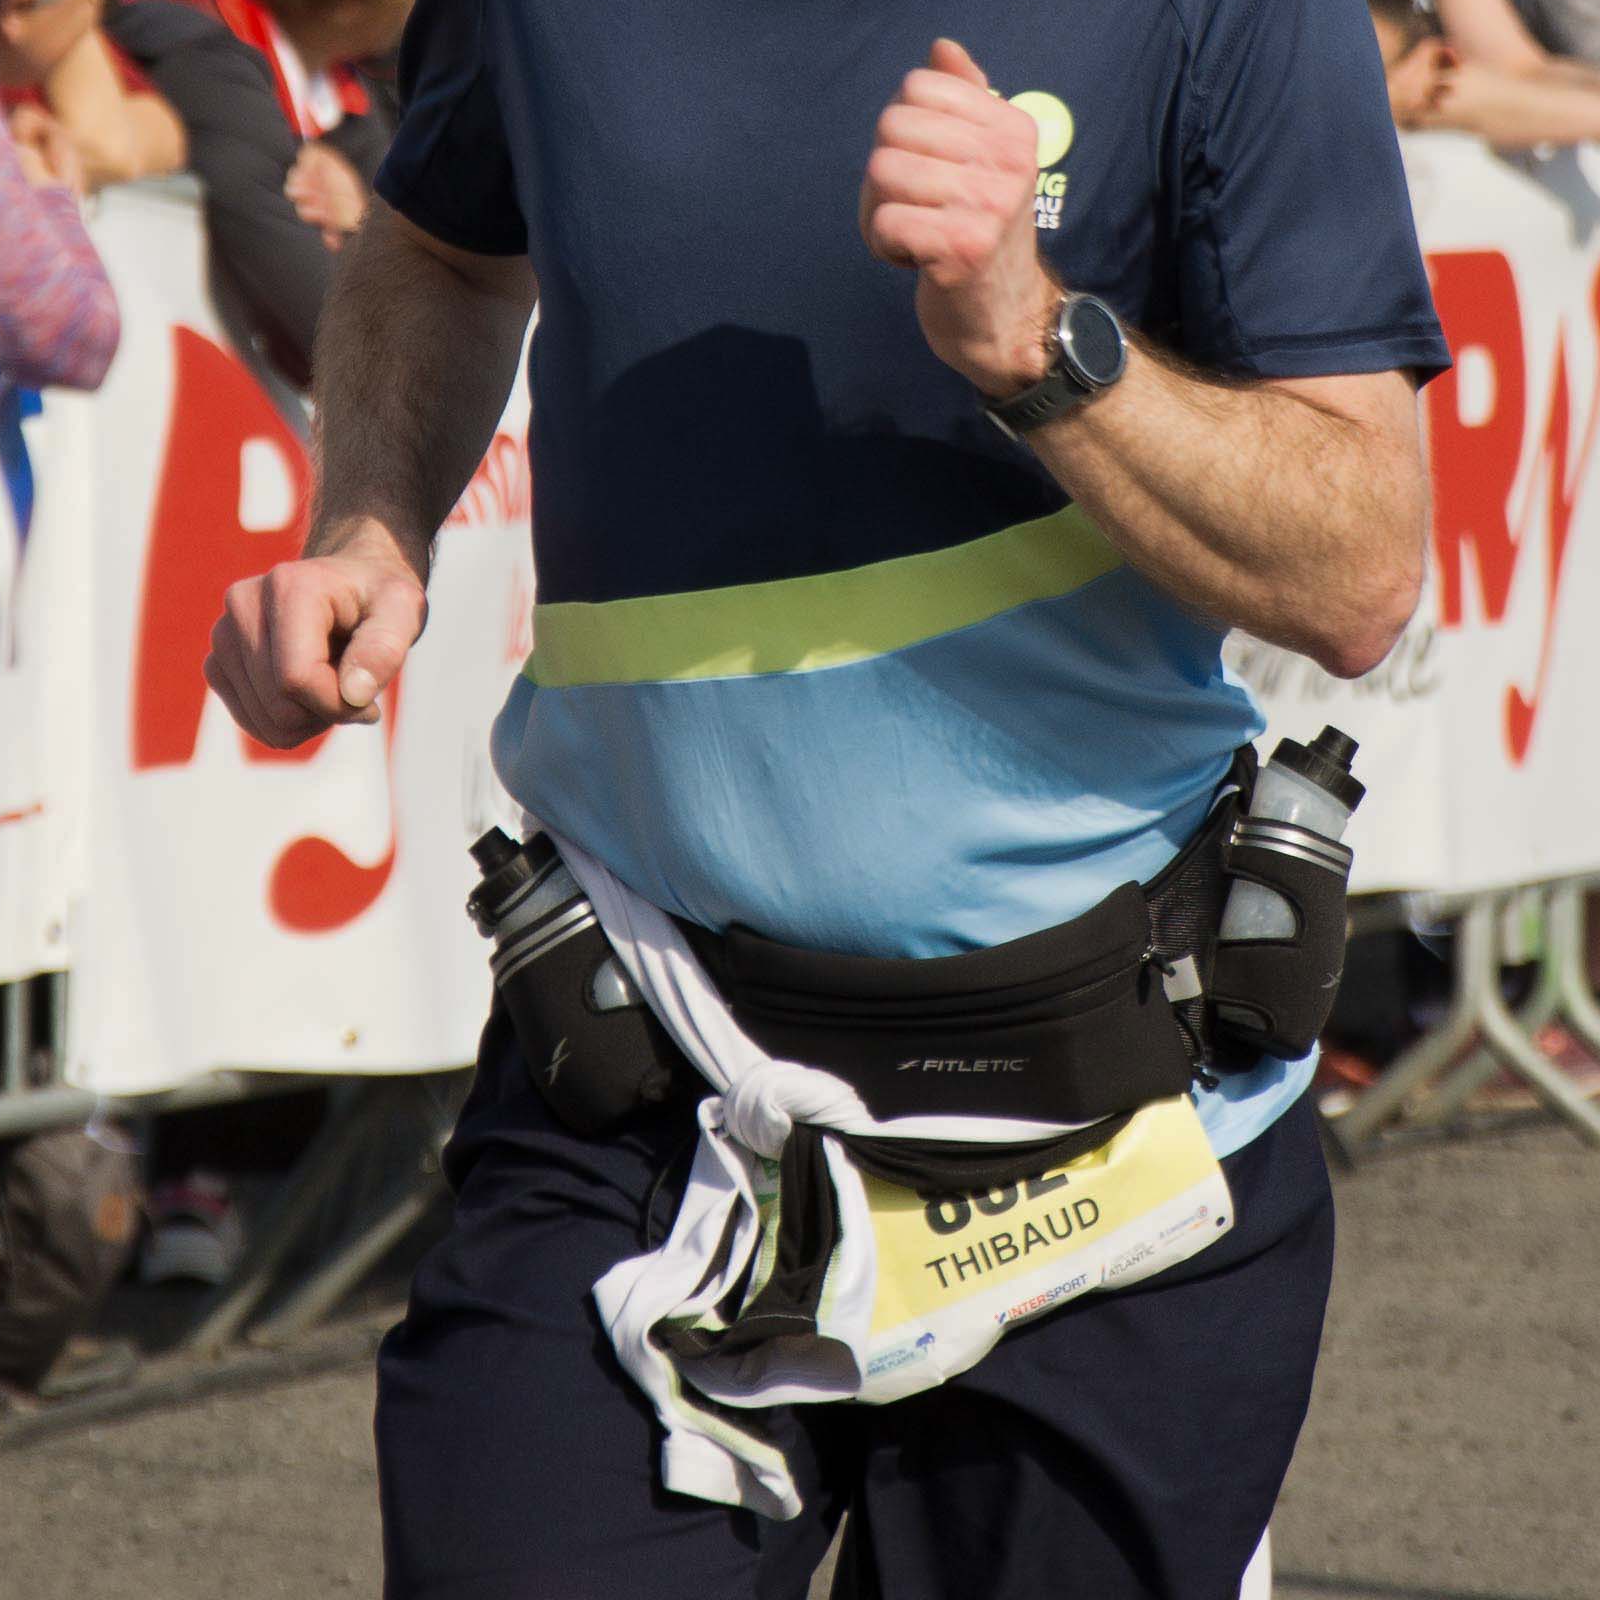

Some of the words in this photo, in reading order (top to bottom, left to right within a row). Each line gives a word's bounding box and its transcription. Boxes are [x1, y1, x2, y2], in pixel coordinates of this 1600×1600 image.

[1033, 196, 1064, 214] AU
[1034, 213, 1060, 229] ES
[922, 1058, 1026, 1072] FITLETIC
[924, 1197, 1101, 1289] THIBAUD
[1006, 1273, 1089, 1321] INTERSPORT
